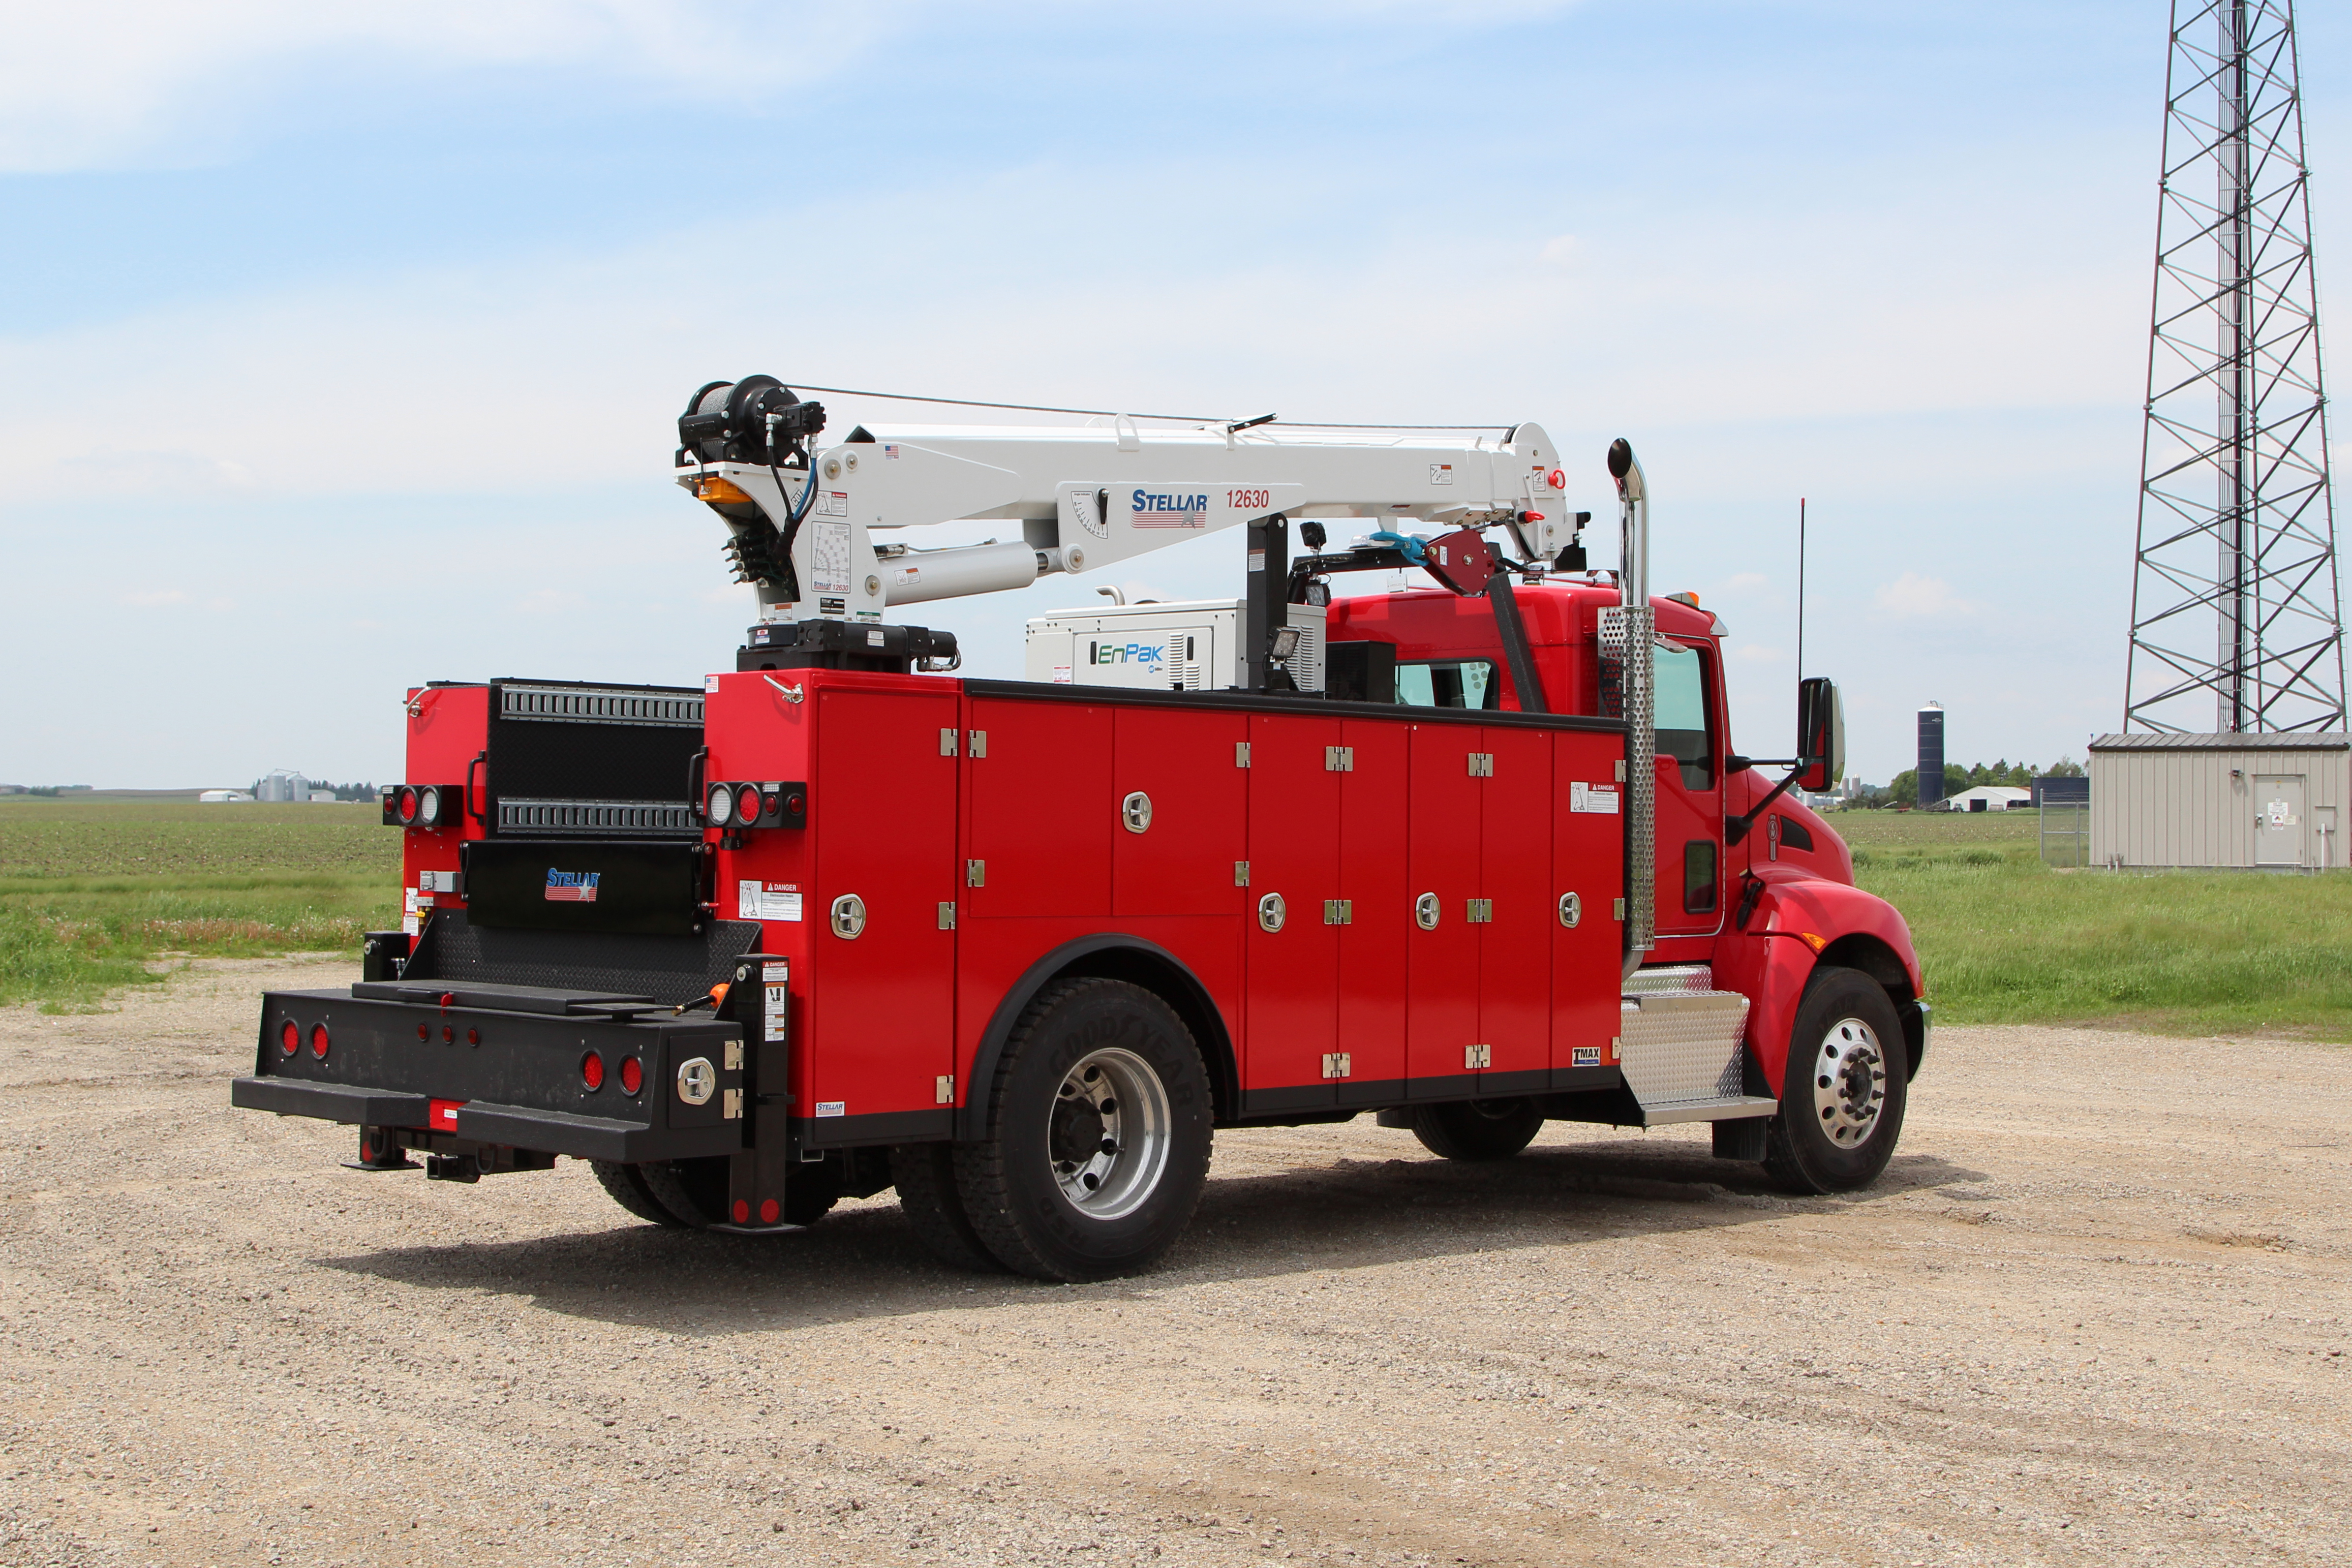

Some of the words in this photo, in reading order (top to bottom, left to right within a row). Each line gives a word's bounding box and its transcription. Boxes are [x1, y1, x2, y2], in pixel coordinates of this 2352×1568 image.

[1132, 489, 1208, 511] STELLAR
[1227, 489, 1269, 508] 12630
[1098, 643, 1165, 664] EnPak
[546, 868, 598, 887] STELLAR
[1049, 1013, 1195, 1108] GOODYEAR
[1574, 1048, 1599, 1065] TMAX
